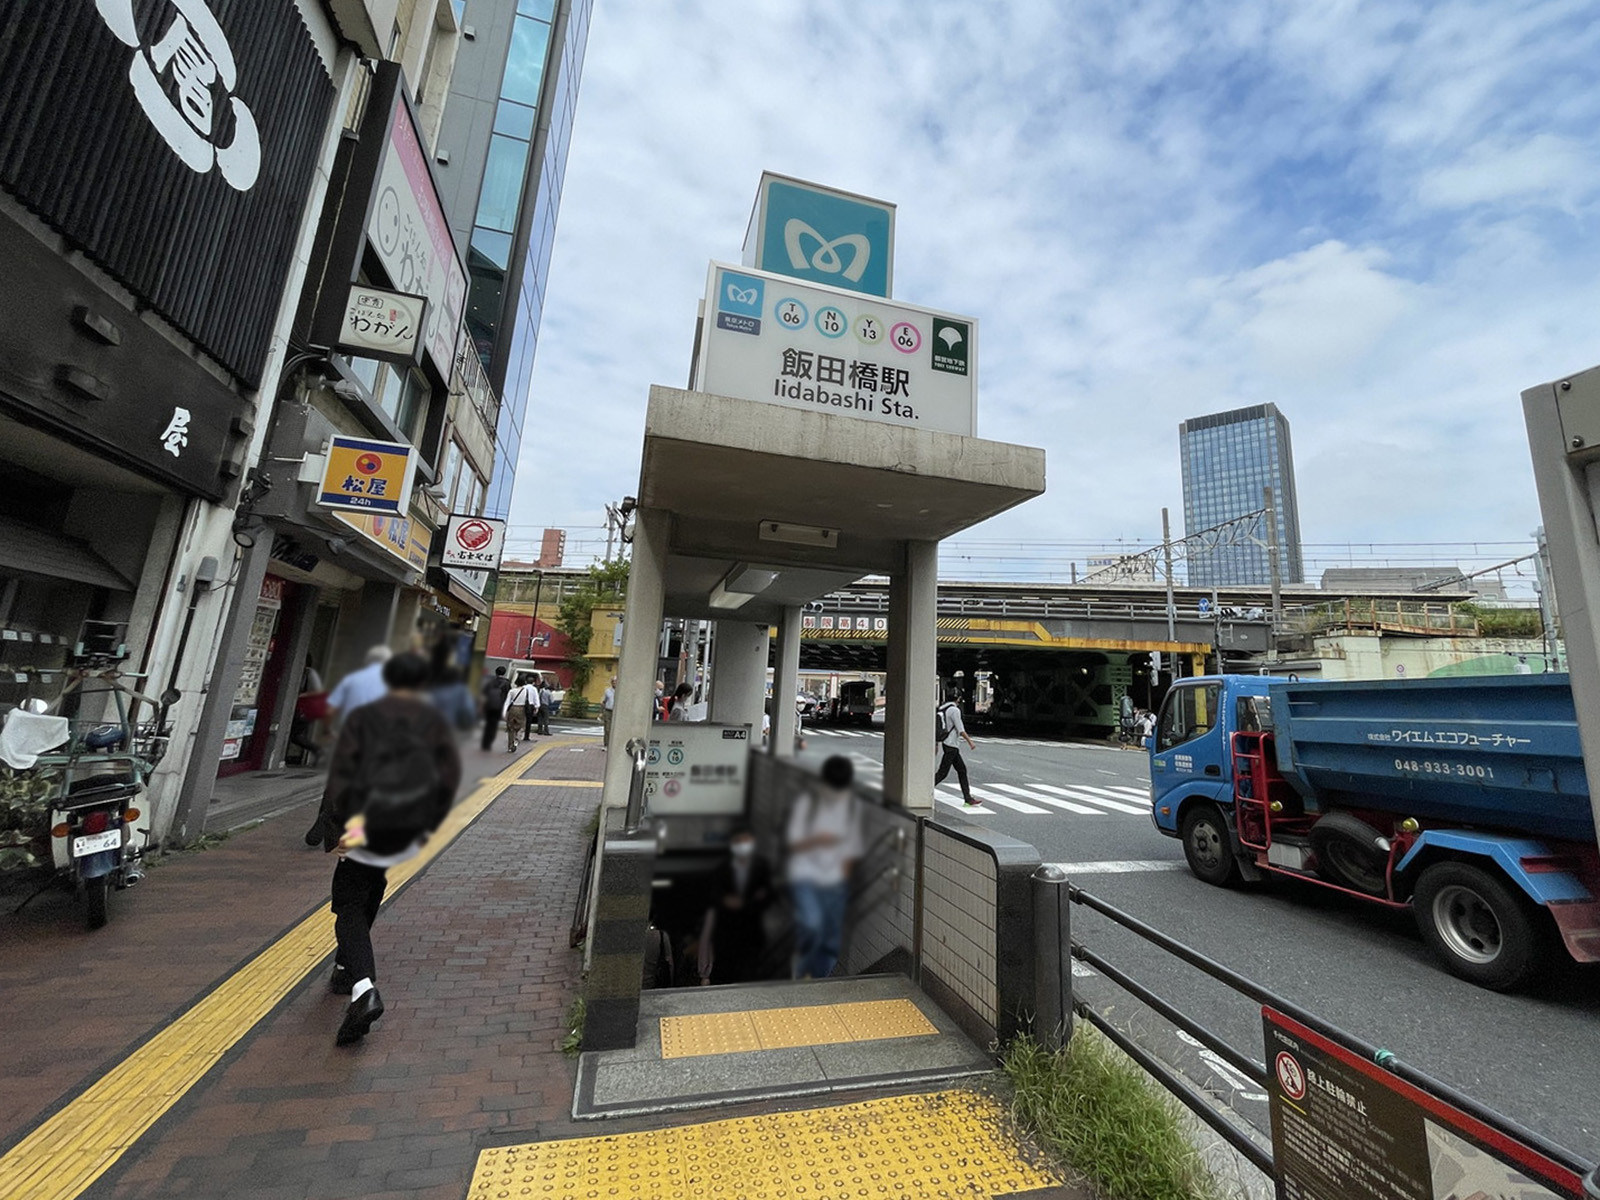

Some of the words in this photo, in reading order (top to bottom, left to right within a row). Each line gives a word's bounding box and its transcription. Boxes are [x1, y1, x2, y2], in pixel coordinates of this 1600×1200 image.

[789, 303, 796, 312] T
[783, 312, 800, 325] 06
[826, 311, 836, 321] N
[350, 315, 413, 339] わがん
[824, 320, 839, 332] 10
[865, 319, 873, 328] Y
[862, 328, 877, 340] 13
[903, 327, 909, 336] E
[898, 335, 914, 347] 06
[781, 347, 910, 397] 飯田橋駅
[774, 379, 873, 412] Iidabashi
[881, 397, 920, 420] Sta.
[342, 475, 387, 496] 松屋
[349, 496, 371, 506] 24h
[734, 731, 746, 739] A4
[1394, 759, 1494, 779] 048-933-3001
